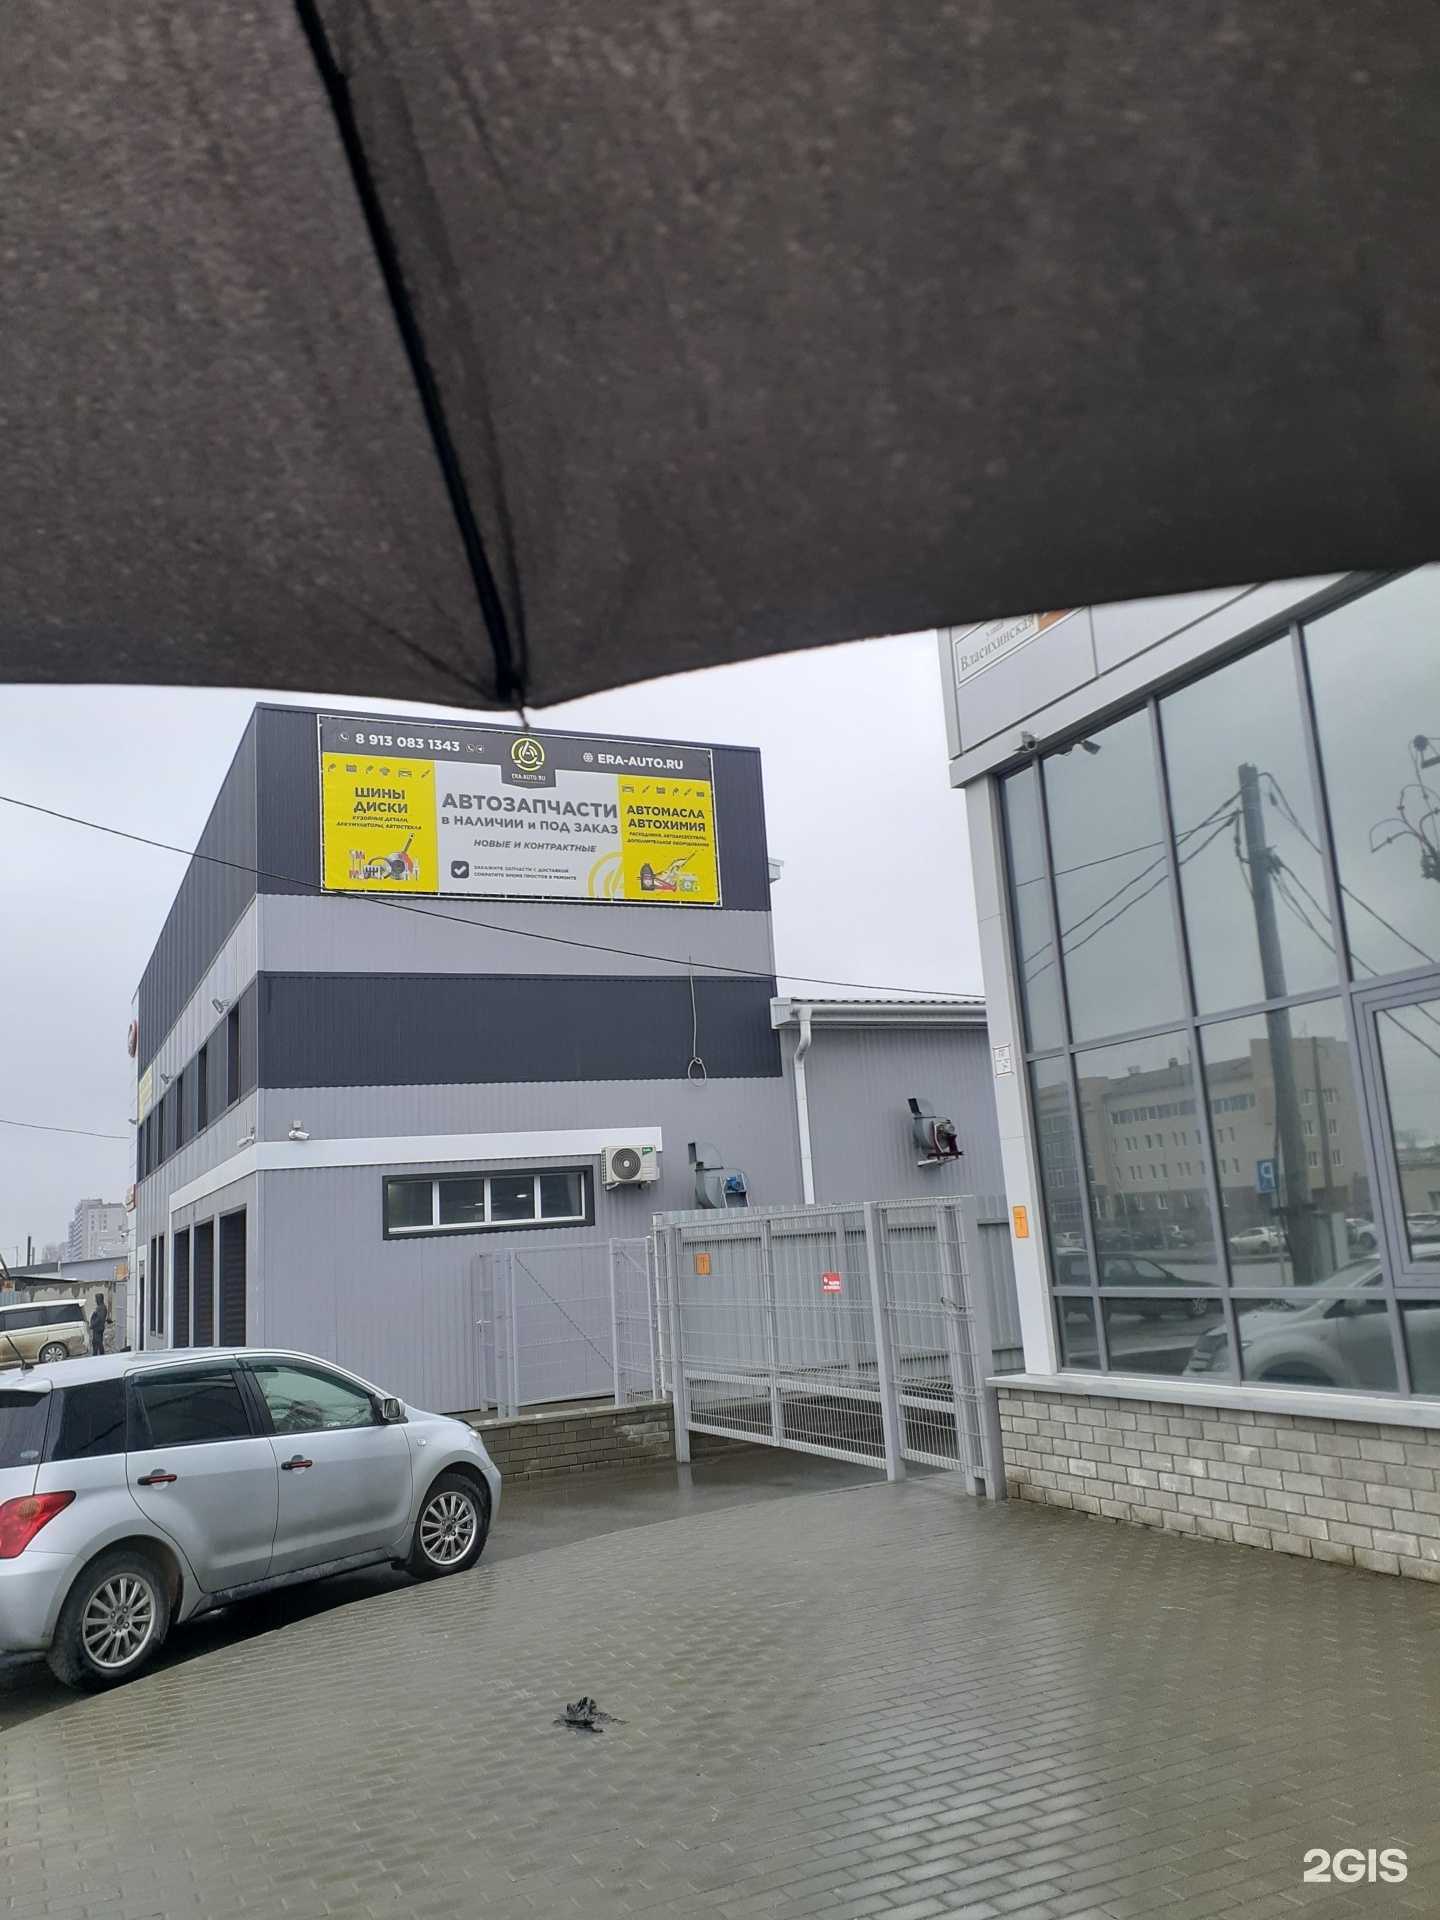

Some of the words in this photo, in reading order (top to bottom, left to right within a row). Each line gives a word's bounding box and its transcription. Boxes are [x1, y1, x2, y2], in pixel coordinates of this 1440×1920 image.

[355, 733, 365, 744] 8
[369, 735, 393, 746] 913
[397, 737, 424, 749] 083
[428, 739, 460, 752] 1343
[597, 753, 684, 770] ERA-AUTO.RU
[354, 787, 406, 800] ШИНЫ
[353, 801, 408, 814] ДИСКИ
[442, 792, 618, 818] АВТОЗАПЧАСТИ
[626, 804, 705, 819] АВТОМАСЛА
[454, 815, 524, 830] НАЛИЧИИ
[540, 820, 570, 835] ПОД
[574, 822, 618, 835] ЗАКАЗ
[628, 818, 706, 832] АВТОХИМИЯ
[474, 839, 512, 849] НОВЫЕ
[513, 840, 522, 849] И
[524, 841, 598, 854] КОНТРАКТНЫЕ
